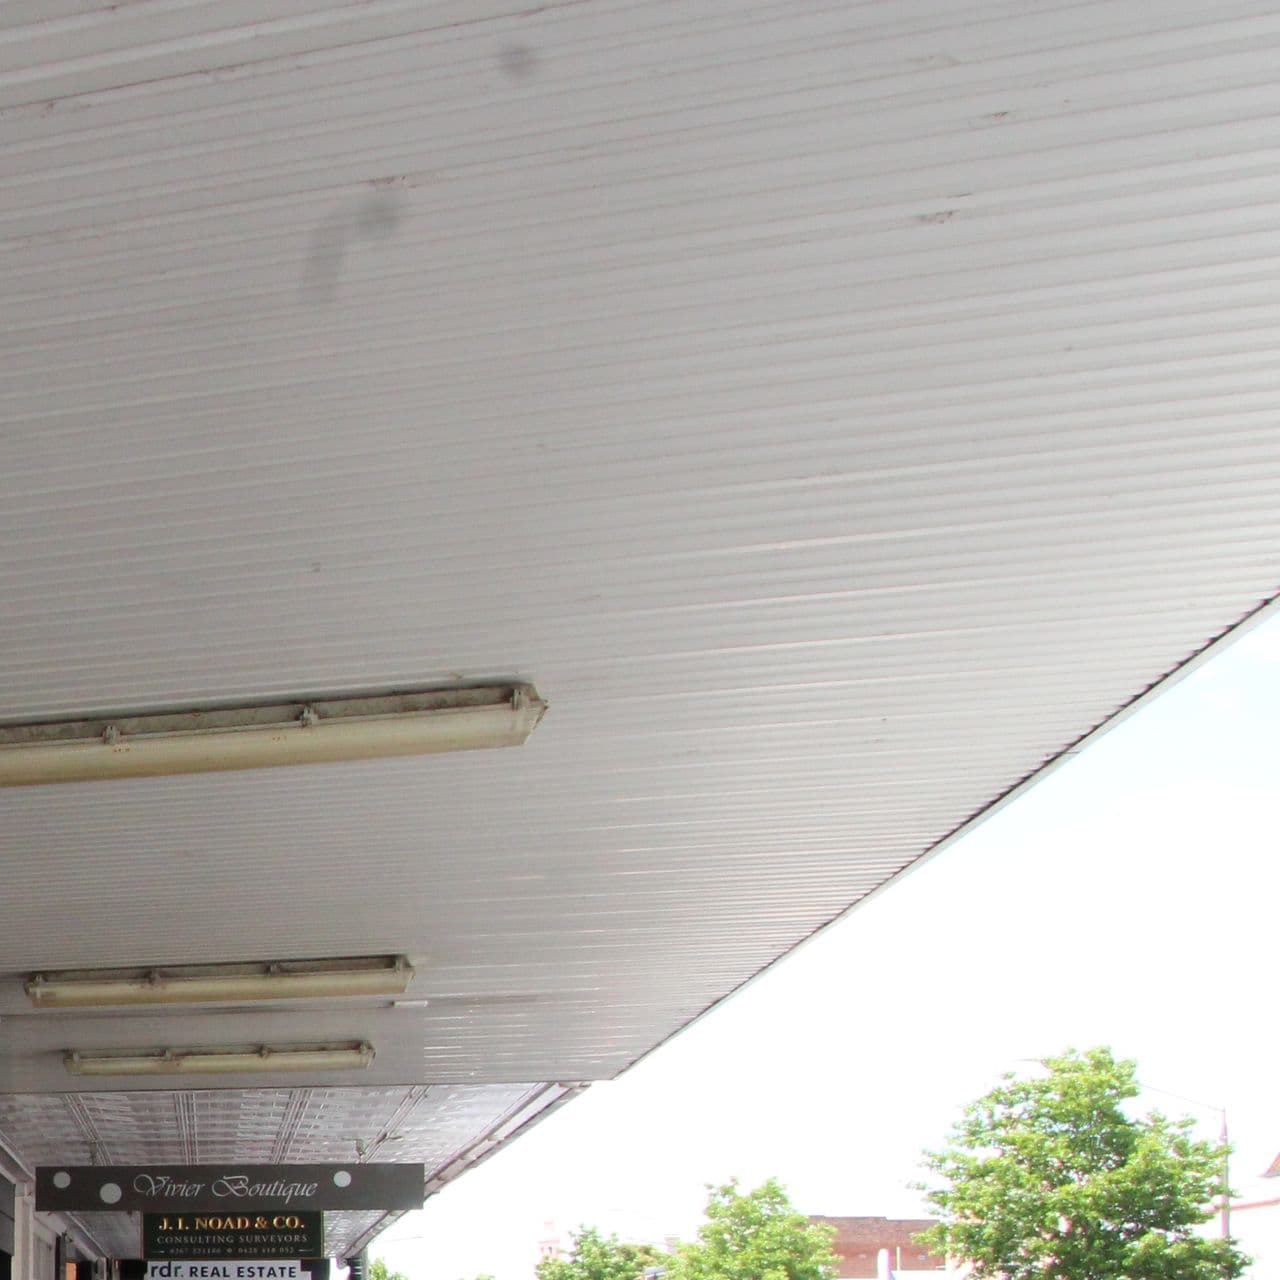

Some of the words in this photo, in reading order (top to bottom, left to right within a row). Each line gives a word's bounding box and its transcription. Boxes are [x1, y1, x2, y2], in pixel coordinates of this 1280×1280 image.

[133, 1174, 205, 1197] Vivier
[211, 1175, 318, 1204] Boutique
[159, 1217, 173, 1231] J.
[195, 1216, 249, 1230] NOAD
[255, 1216, 268, 1229] &
[273, 1216, 305, 1229] CO.
[157, 1234, 234, 1244] CONSULTING
[239, 1234, 308, 1243] SURVEYORS
[190, 1266, 230, 1278] REAL
[237, 1266, 297, 1278] ESTATE
